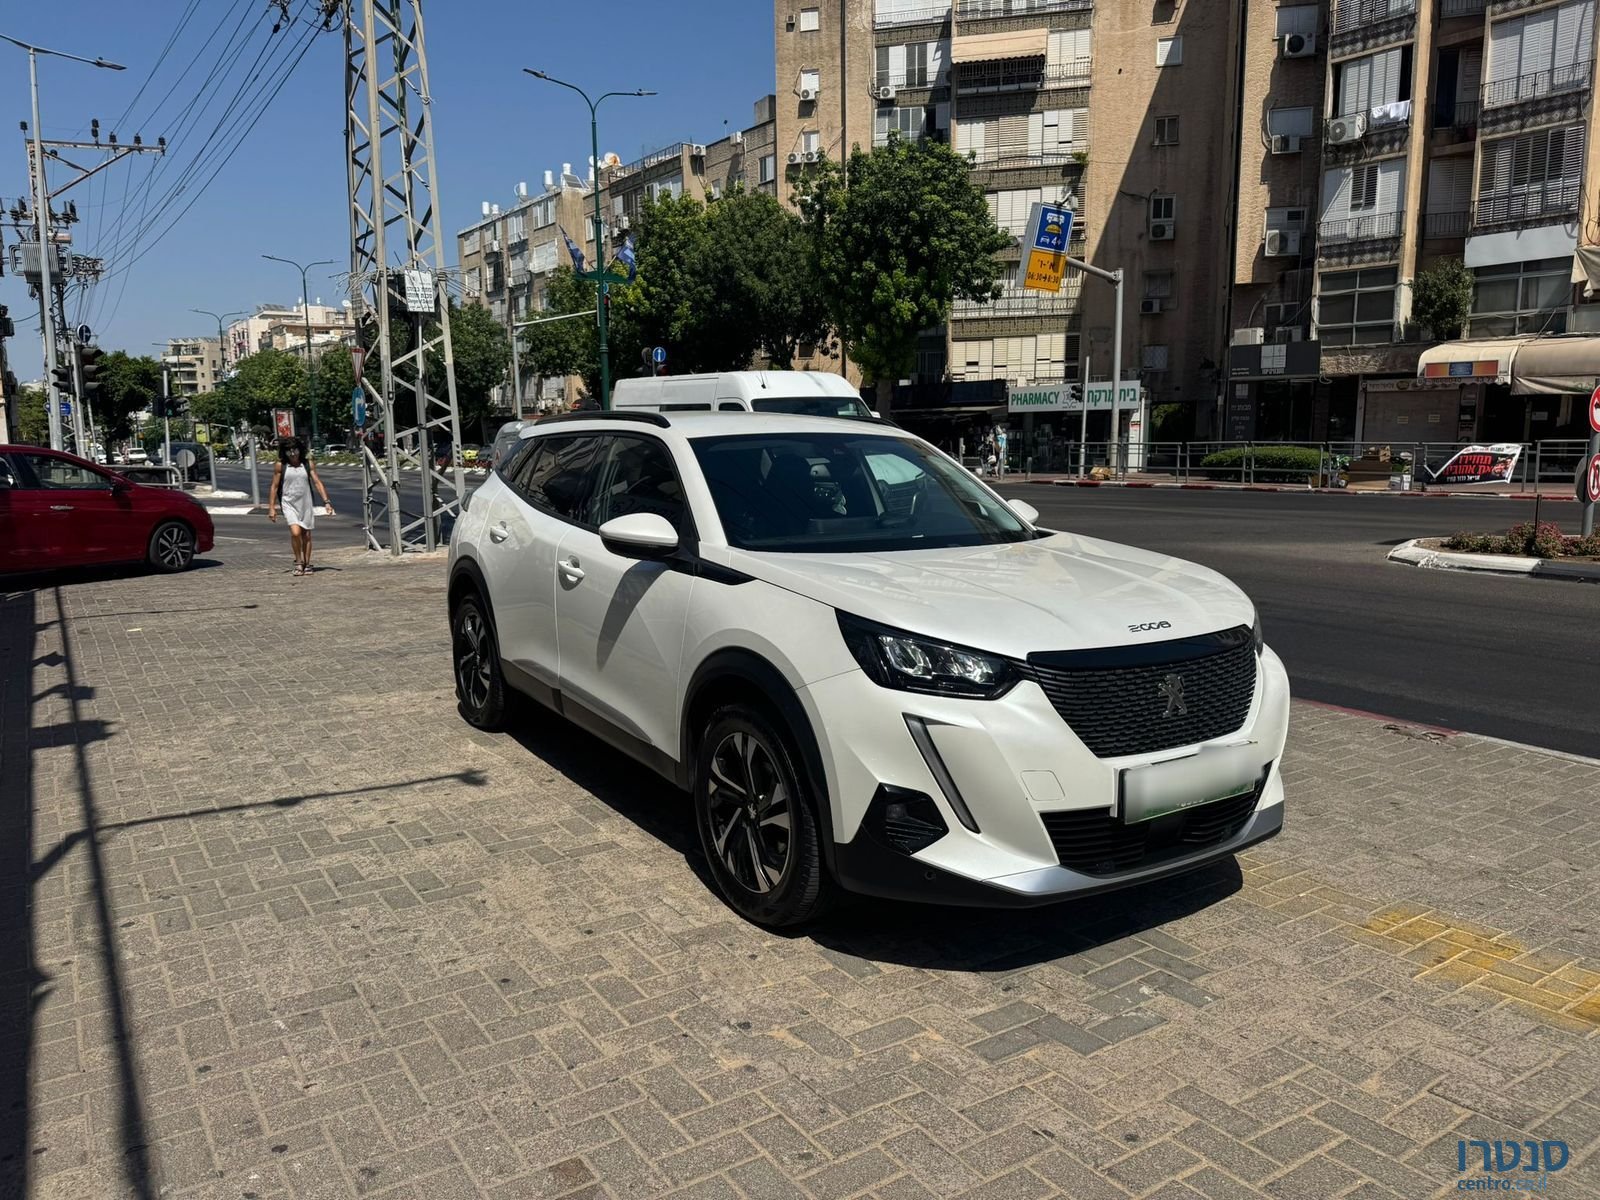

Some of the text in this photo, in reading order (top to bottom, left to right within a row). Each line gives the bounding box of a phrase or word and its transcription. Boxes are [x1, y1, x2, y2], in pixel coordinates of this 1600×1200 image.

[1011, 391, 1060, 406] PHARMACY
[1119, 388, 1137, 402] בית
[1459, 454, 1492, 465] תחזירו
[1128, 620, 1172, 633] 2008
